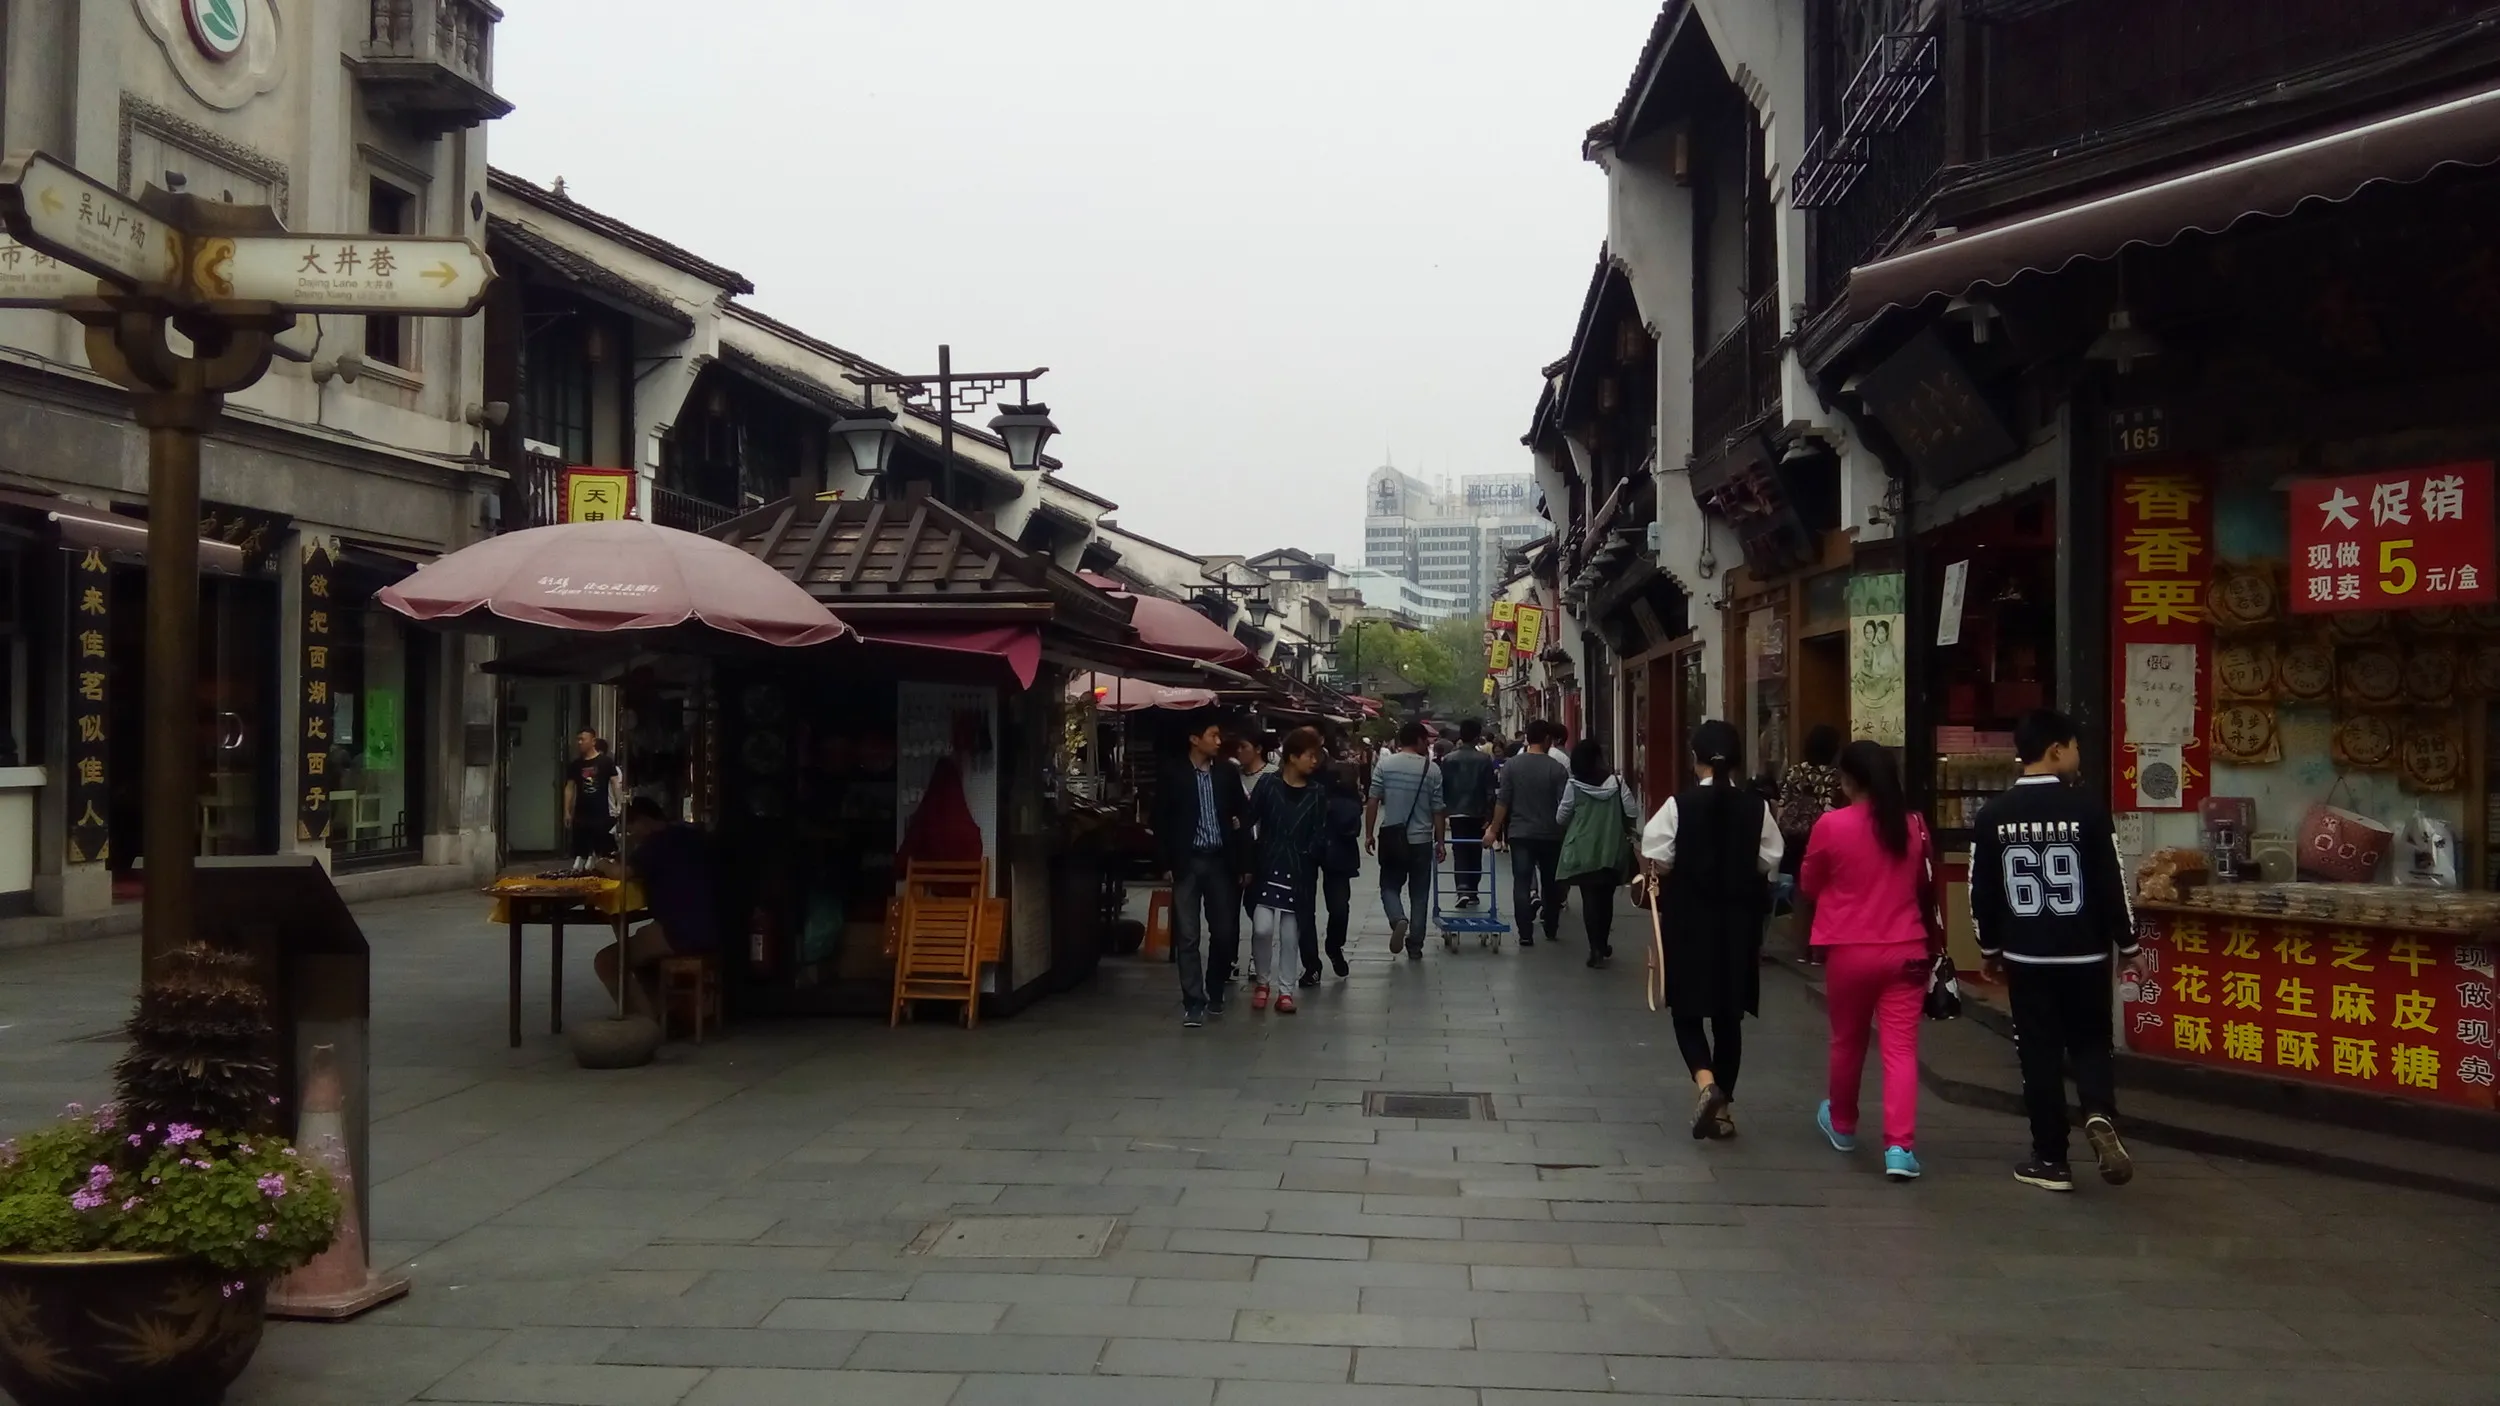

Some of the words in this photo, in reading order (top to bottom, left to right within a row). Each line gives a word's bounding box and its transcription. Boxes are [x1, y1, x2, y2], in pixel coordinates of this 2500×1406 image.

[78, 192, 146, 249] 吴山广场
[297, 244, 398, 276] 大井巷
[2120, 425, 2160, 452] 165
[2122, 474, 2204, 625] 香香栗
[2307, 541, 2361, 570] 现做
[2317, 474, 2465, 533] 大促销
[2307, 572, 2361, 601] 现卖
[2378, 538, 2418, 596] 5
[2425, 563, 2480, 593] 元/盒
[77, 548, 108, 828] 从来佳茗似佳人
[305, 574, 330, 812] 欲把西湖比西子
[1997, 821, 2081, 843] EVENAGE
[2001, 843, 2084, 917] 69
[2169, 916, 2213, 1055] 桂花酥
[2219, 921, 2265, 1064] 龙须糖
[2272, 924, 2321, 1072] 花生酥
[2329, 929, 2380, 1080] 芝麻酥
[2387, 934, 2441, 1090] 牛皮糖
[2455, 945, 2495, 1086] 现做现卖
